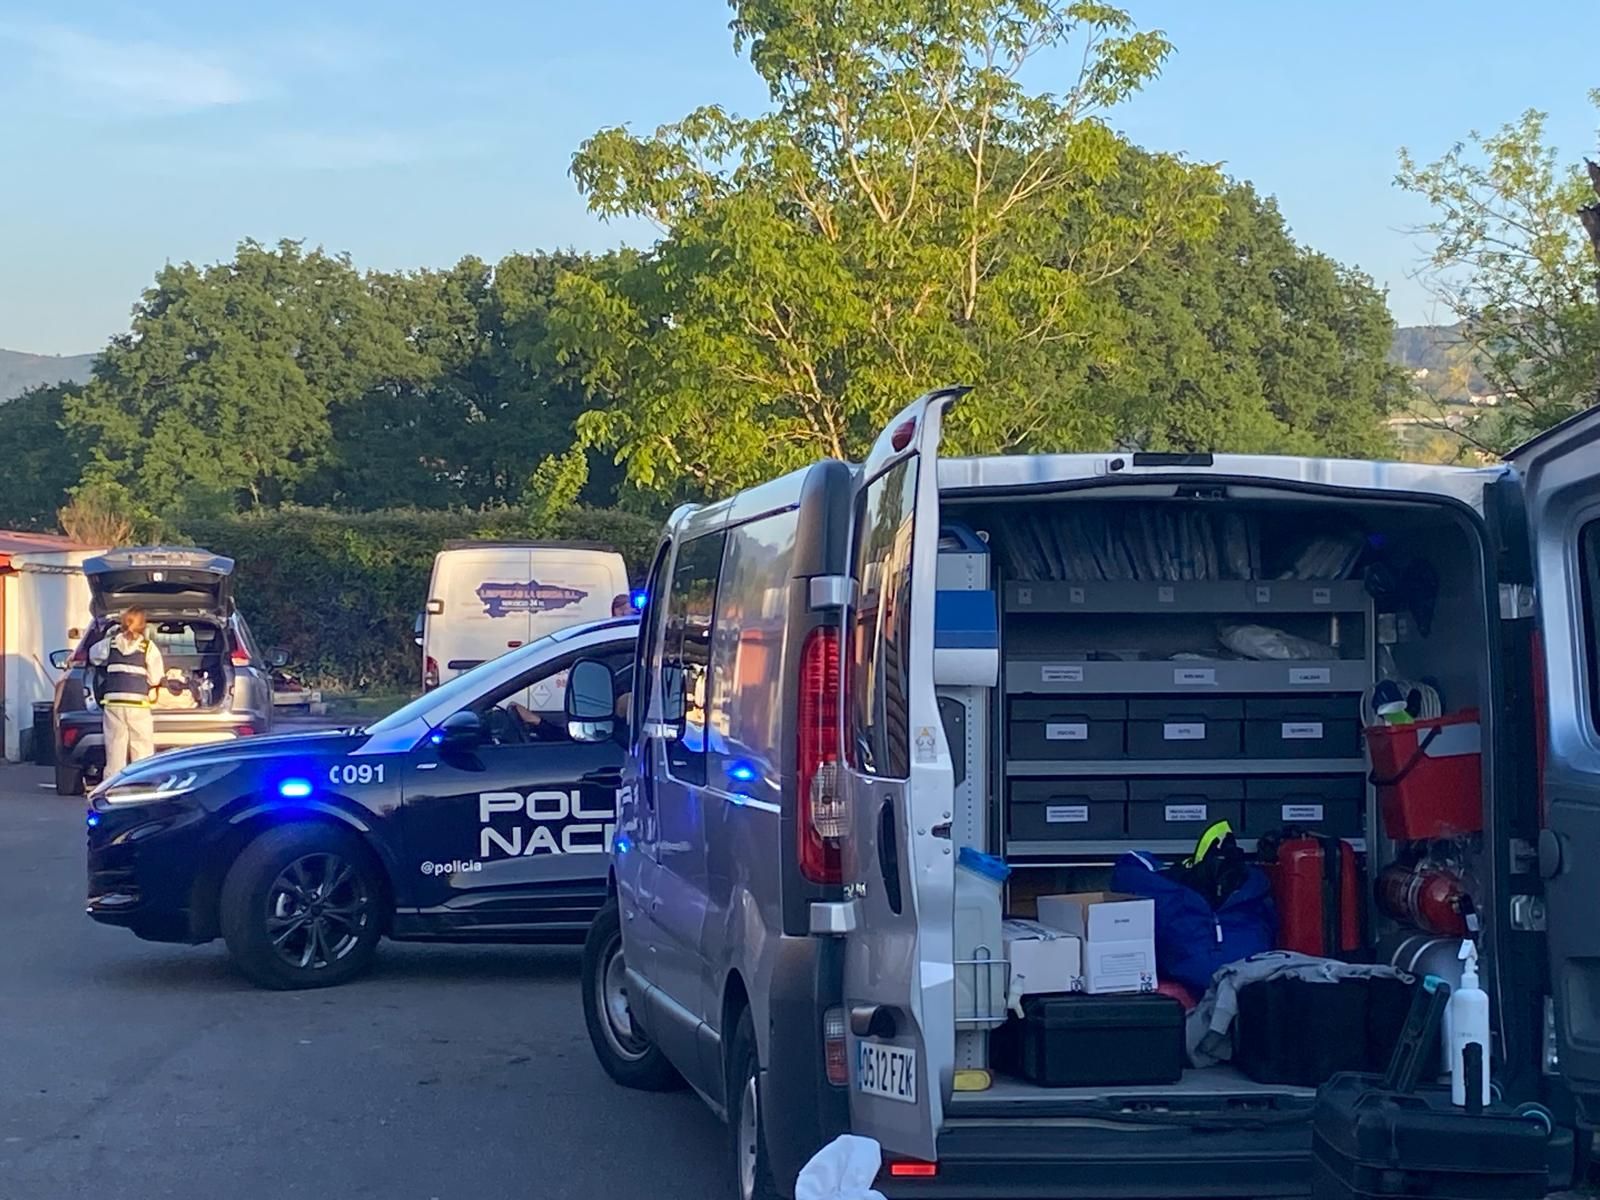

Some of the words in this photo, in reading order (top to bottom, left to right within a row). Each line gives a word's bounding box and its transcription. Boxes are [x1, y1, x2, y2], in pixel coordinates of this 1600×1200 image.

[343, 763, 384, 784] 091
[421, 859, 482, 876] @policia
[891, 1052, 913, 1097] FZK
